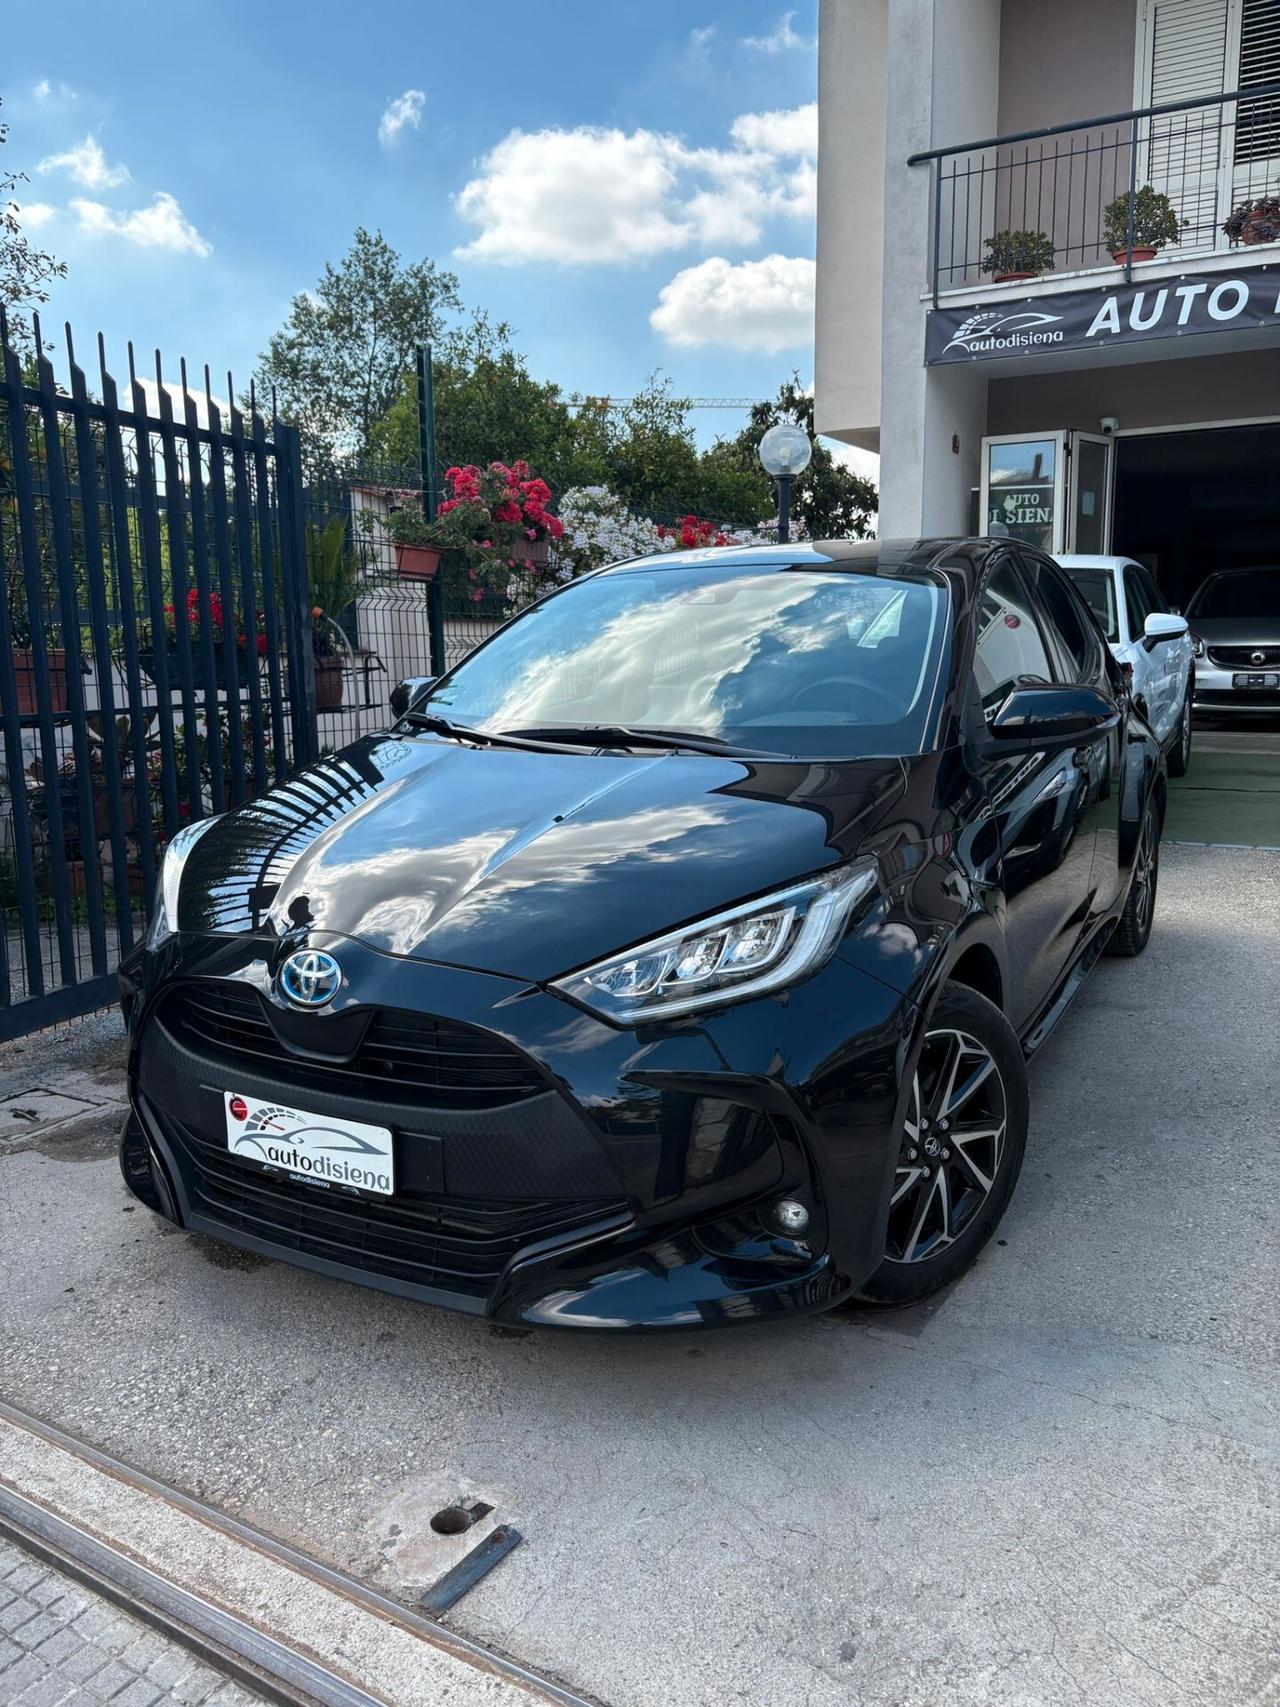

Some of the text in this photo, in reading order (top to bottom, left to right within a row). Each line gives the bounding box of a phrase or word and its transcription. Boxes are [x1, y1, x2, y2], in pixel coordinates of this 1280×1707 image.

[1085, 280, 1250, 337] AUTO
[969, 330, 1064, 352] autodisiena
[1006, 508, 1053, 523] SIEN
[267, 1146, 390, 1190] autodisiena
[290, 1174, 331, 1188] autodisiena
